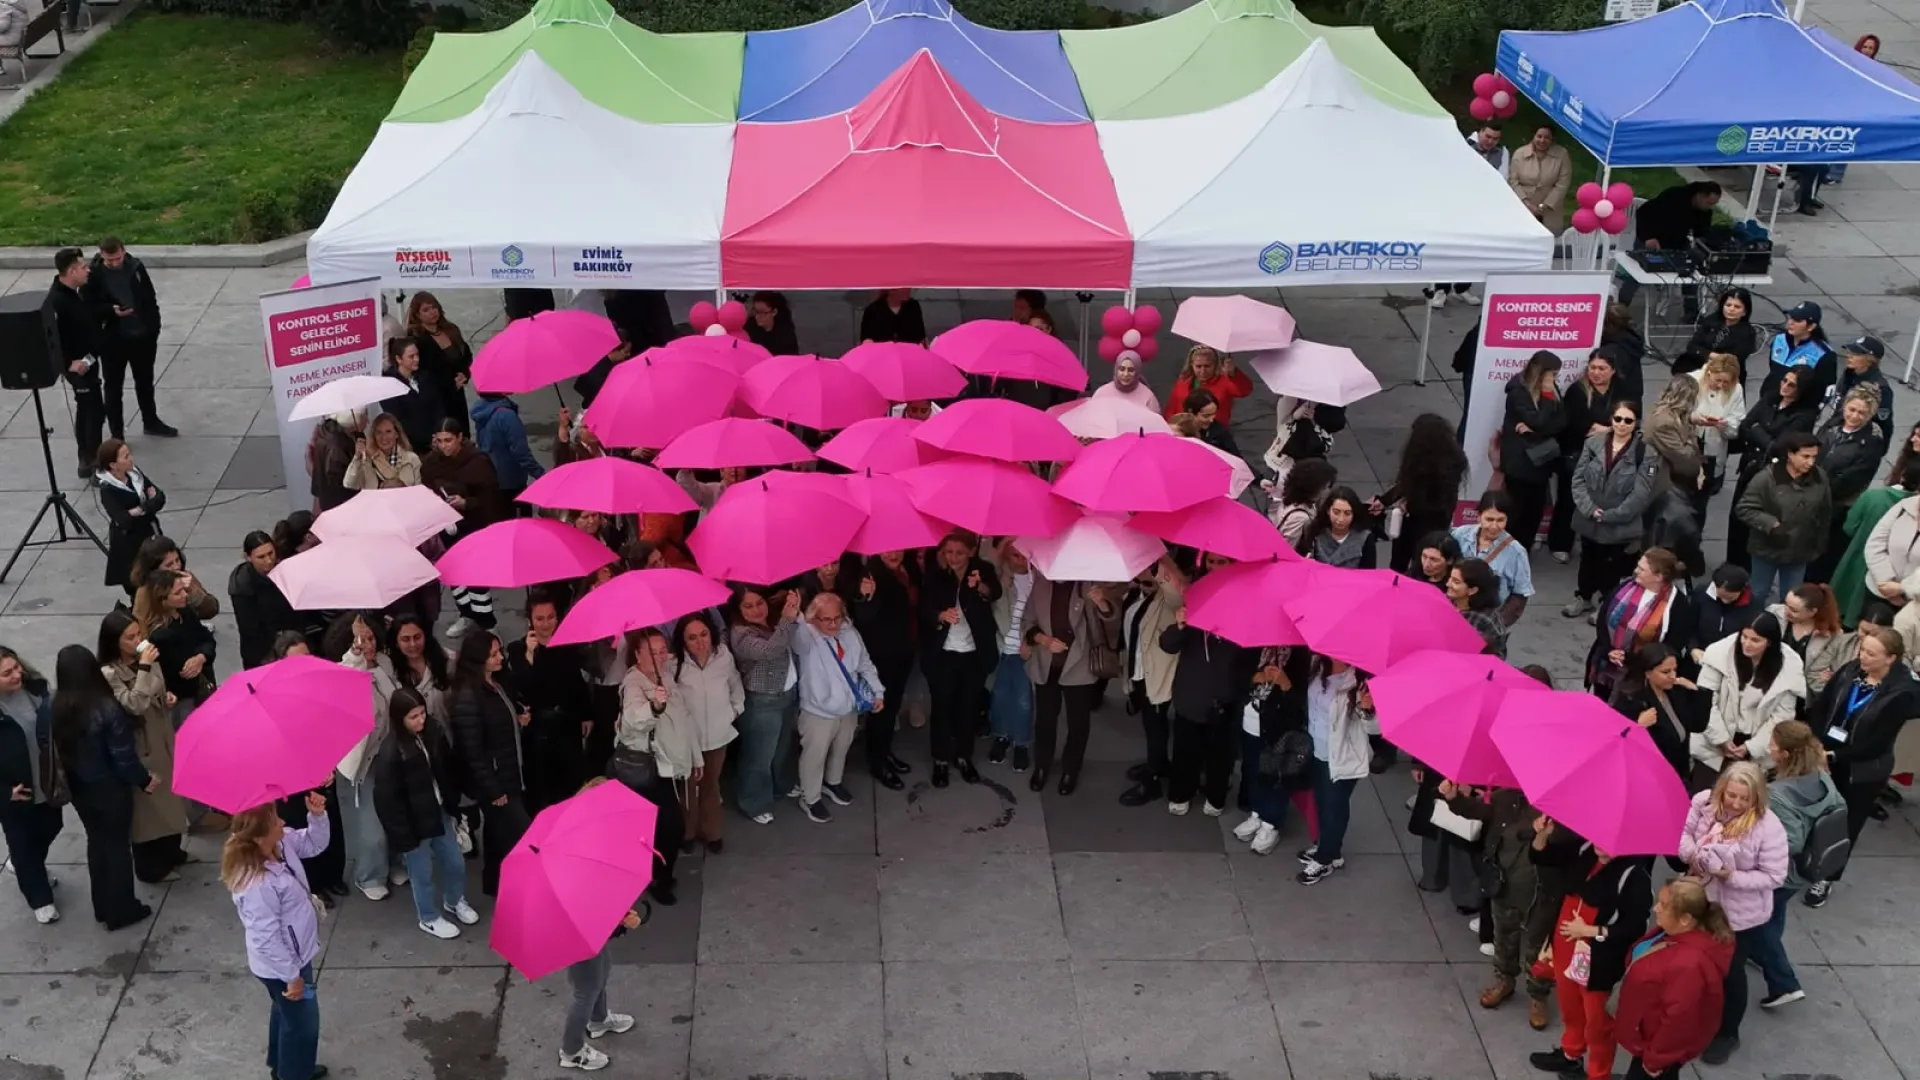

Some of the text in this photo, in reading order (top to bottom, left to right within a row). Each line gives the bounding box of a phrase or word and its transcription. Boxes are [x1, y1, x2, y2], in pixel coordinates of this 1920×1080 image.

[1749, 126, 1861, 140] BAKIRKÖY
[395, 249, 452, 263] AYŞEGÜL
[582, 246, 622, 259] EVİMİZ
[1297, 241, 1426, 257] BAKIRKÖY
[573, 260, 633, 272] BAKIRKÖY
[1496, 302, 1593, 313] KONTROL SENDE
[277, 306, 369, 332] KONTROL SENDE
[1517, 317, 1569, 327] GELECEK
[300, 324, 348, 340] GELECEK
[1502, 329, 1579, 341] SENİN ELİNDE
[289, 334, 361, 357] SENİN ELİNDE
[289, 357, 367, 385] MEME KANSERİ
